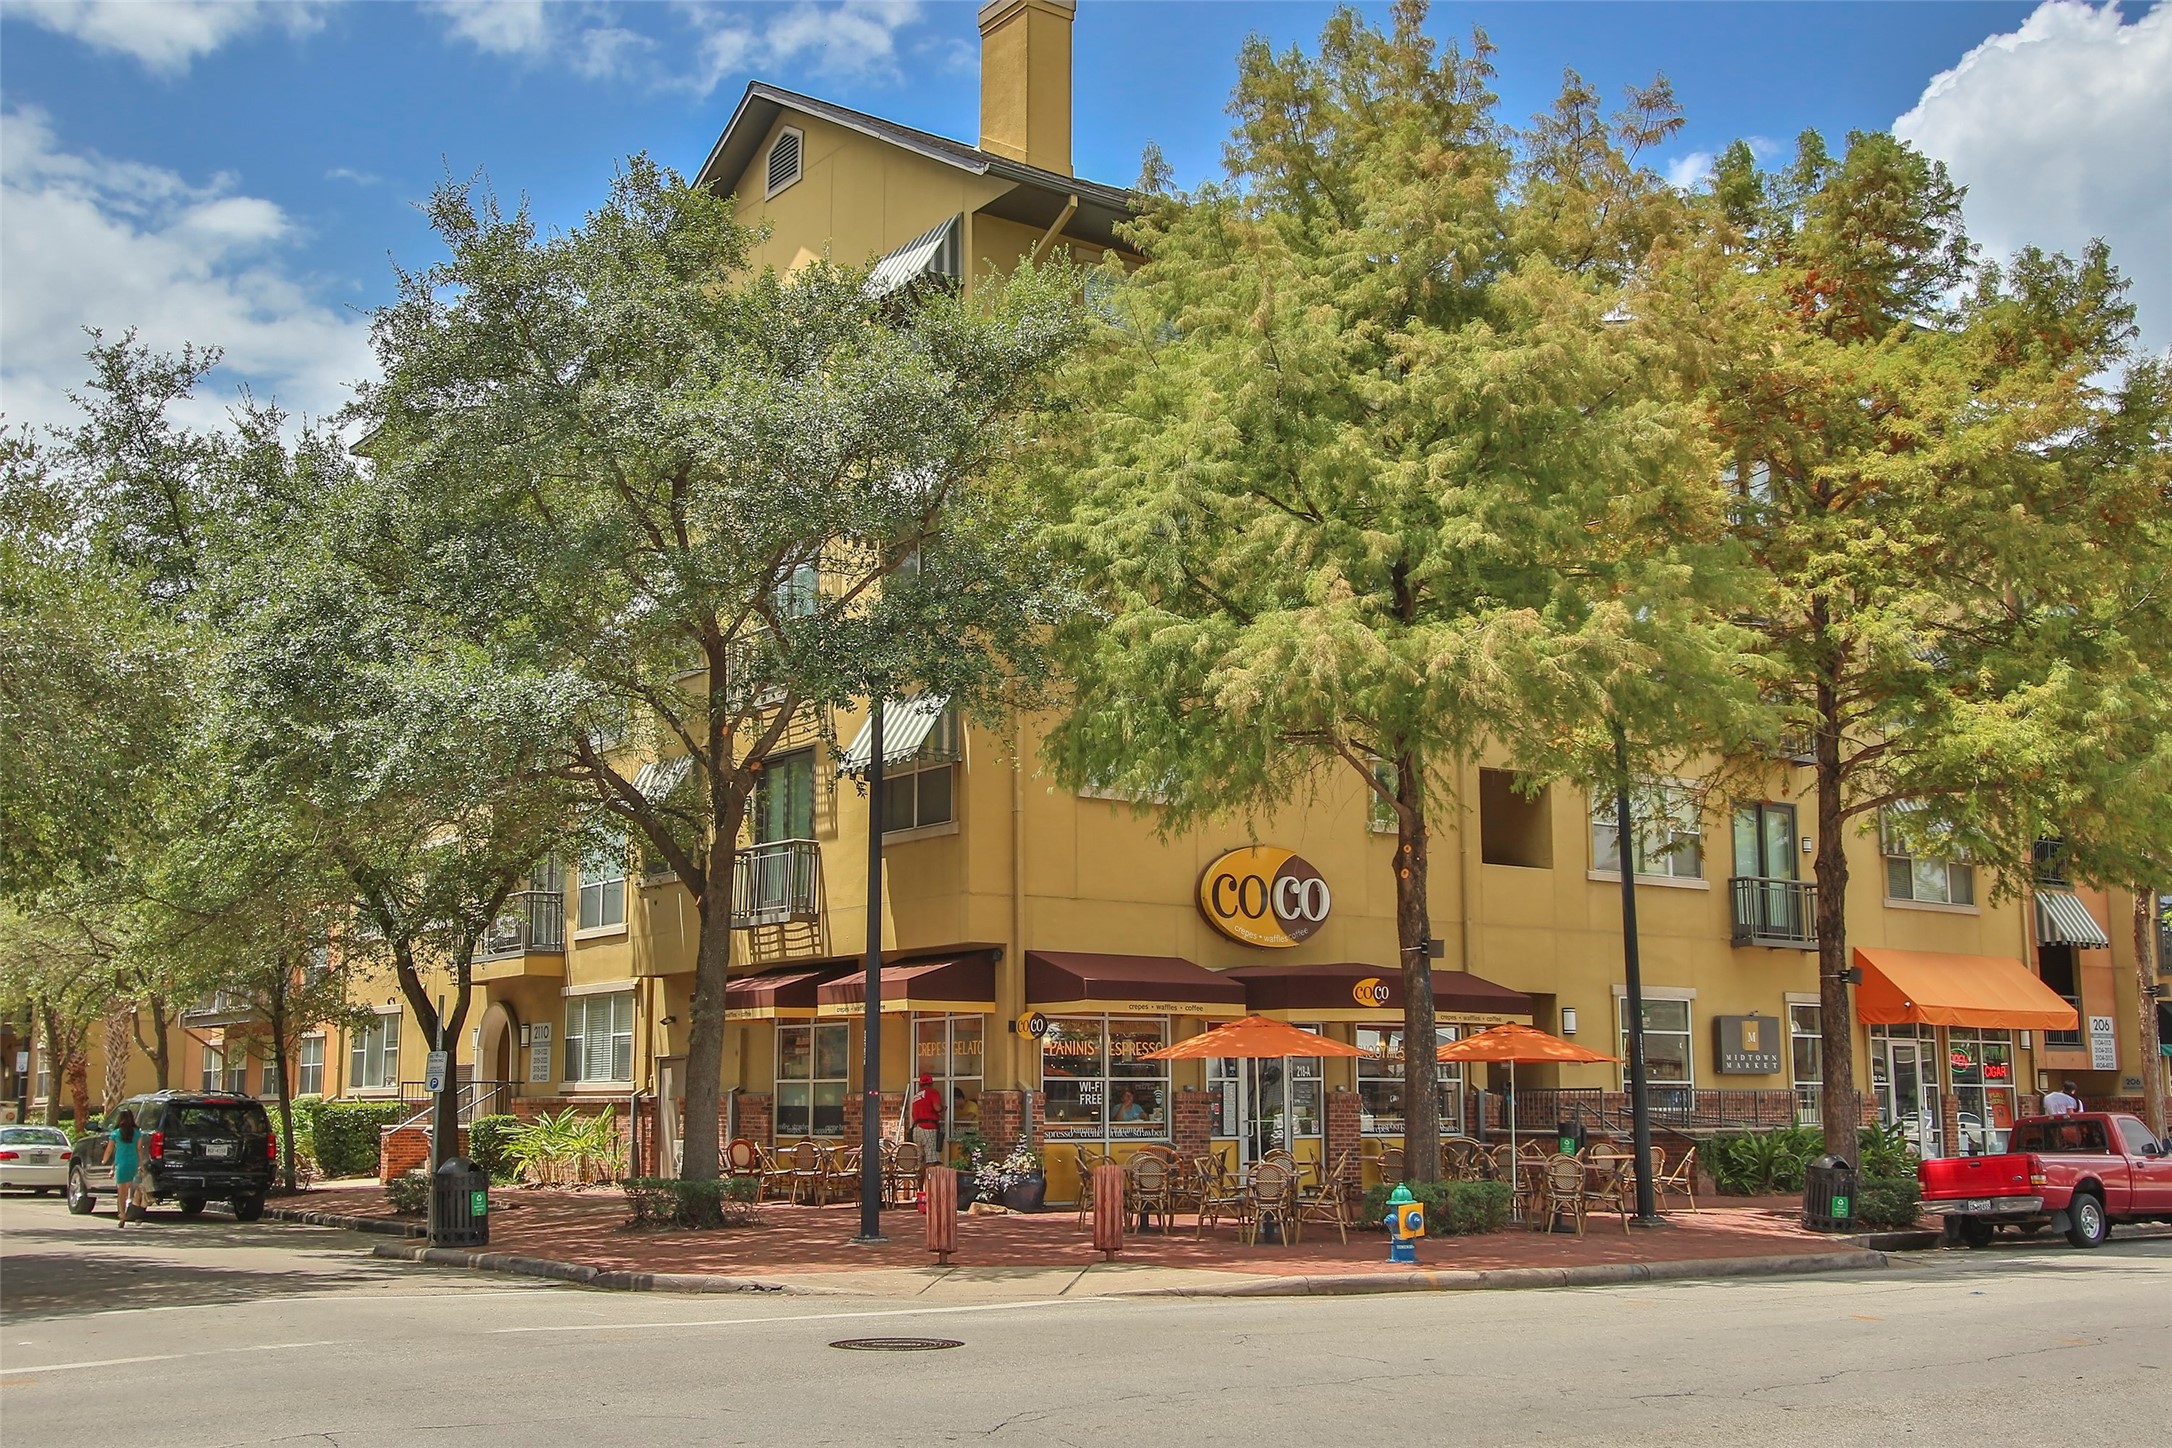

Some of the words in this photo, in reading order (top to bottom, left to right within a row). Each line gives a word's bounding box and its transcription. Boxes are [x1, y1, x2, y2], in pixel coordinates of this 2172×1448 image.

[1211, 873, 1331, 921] COCO
[1234, 925, 1258, 939] crepes
[1264, 932, 1289, 943] waffles
[1289, 927, 1310, 940] coffee
[1354, 985, 1390, 1000] COCO
[1128, 1003, 1149, 1011] crepes
[1184, 1004, 1204, 1012] coffee
[1017, 1018, 1044, 1033] COCO
[2093, 1018, 2110, 1031] 206
[533, 1025, 550, 1039] 2110
[1747, 1031, 1756, 1042] M
[917, 1042, 946, 1056] CREPES
[953, 1040, 982, 1055] GELATO
[1050, 1040, 1095, 1056] PANINIS
[1109, 1041, 1164, 1057] ESPRESSO
[1725, 1053, 1778, 1062] MIDTOWN
[1079, 1081, 1103, 1093] WI-FI
[2126, 1078, 2140, 1086] 206
[1079, 1093, 1103, 1105] FREE
[1044, 1130, 1074, 1139] spresso
[1132, 1129, 1167, 1138] strawberr
